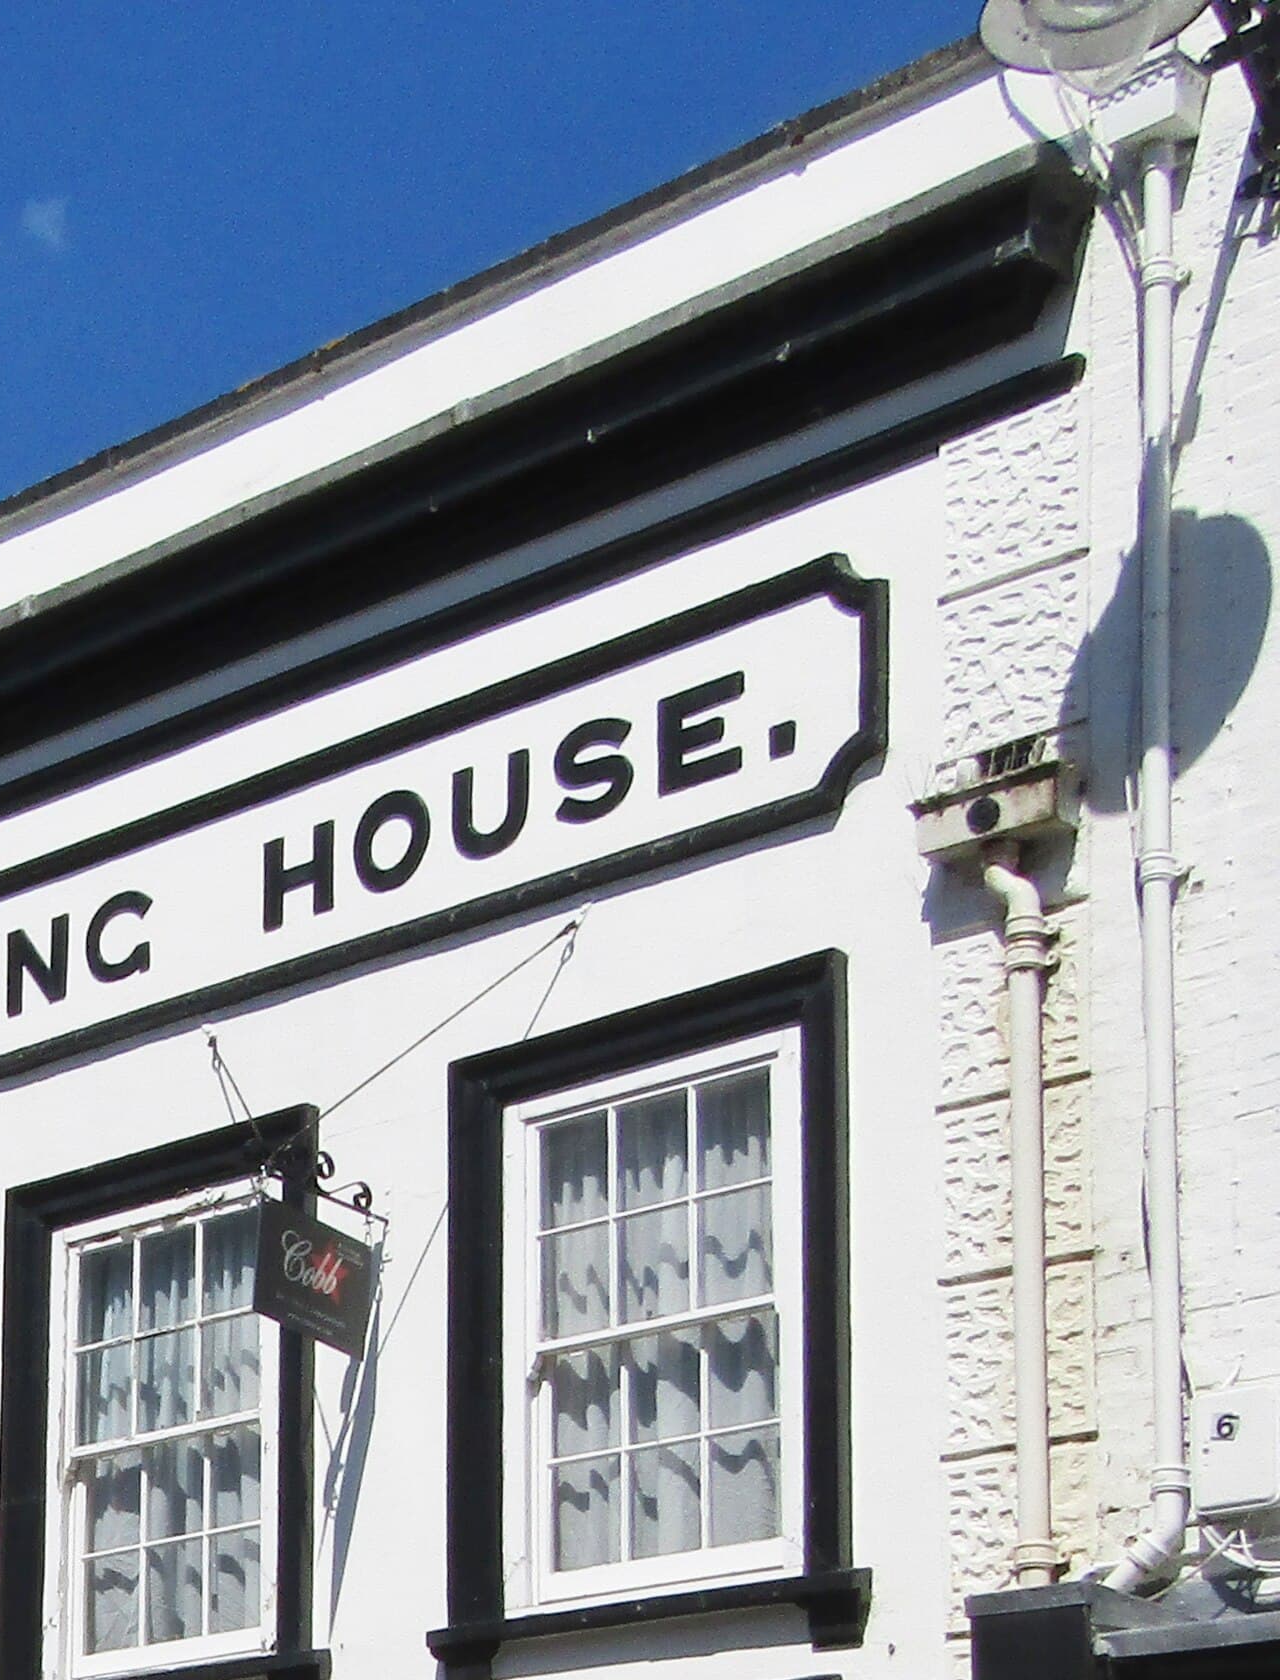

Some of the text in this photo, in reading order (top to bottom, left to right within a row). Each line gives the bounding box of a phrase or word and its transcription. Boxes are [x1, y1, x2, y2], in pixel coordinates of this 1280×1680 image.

[262, 671, 797, 932] HOUSE.
[282, 1230, 344, 1295] Cobb
[1216, 1413, 1240, 1439] 6
